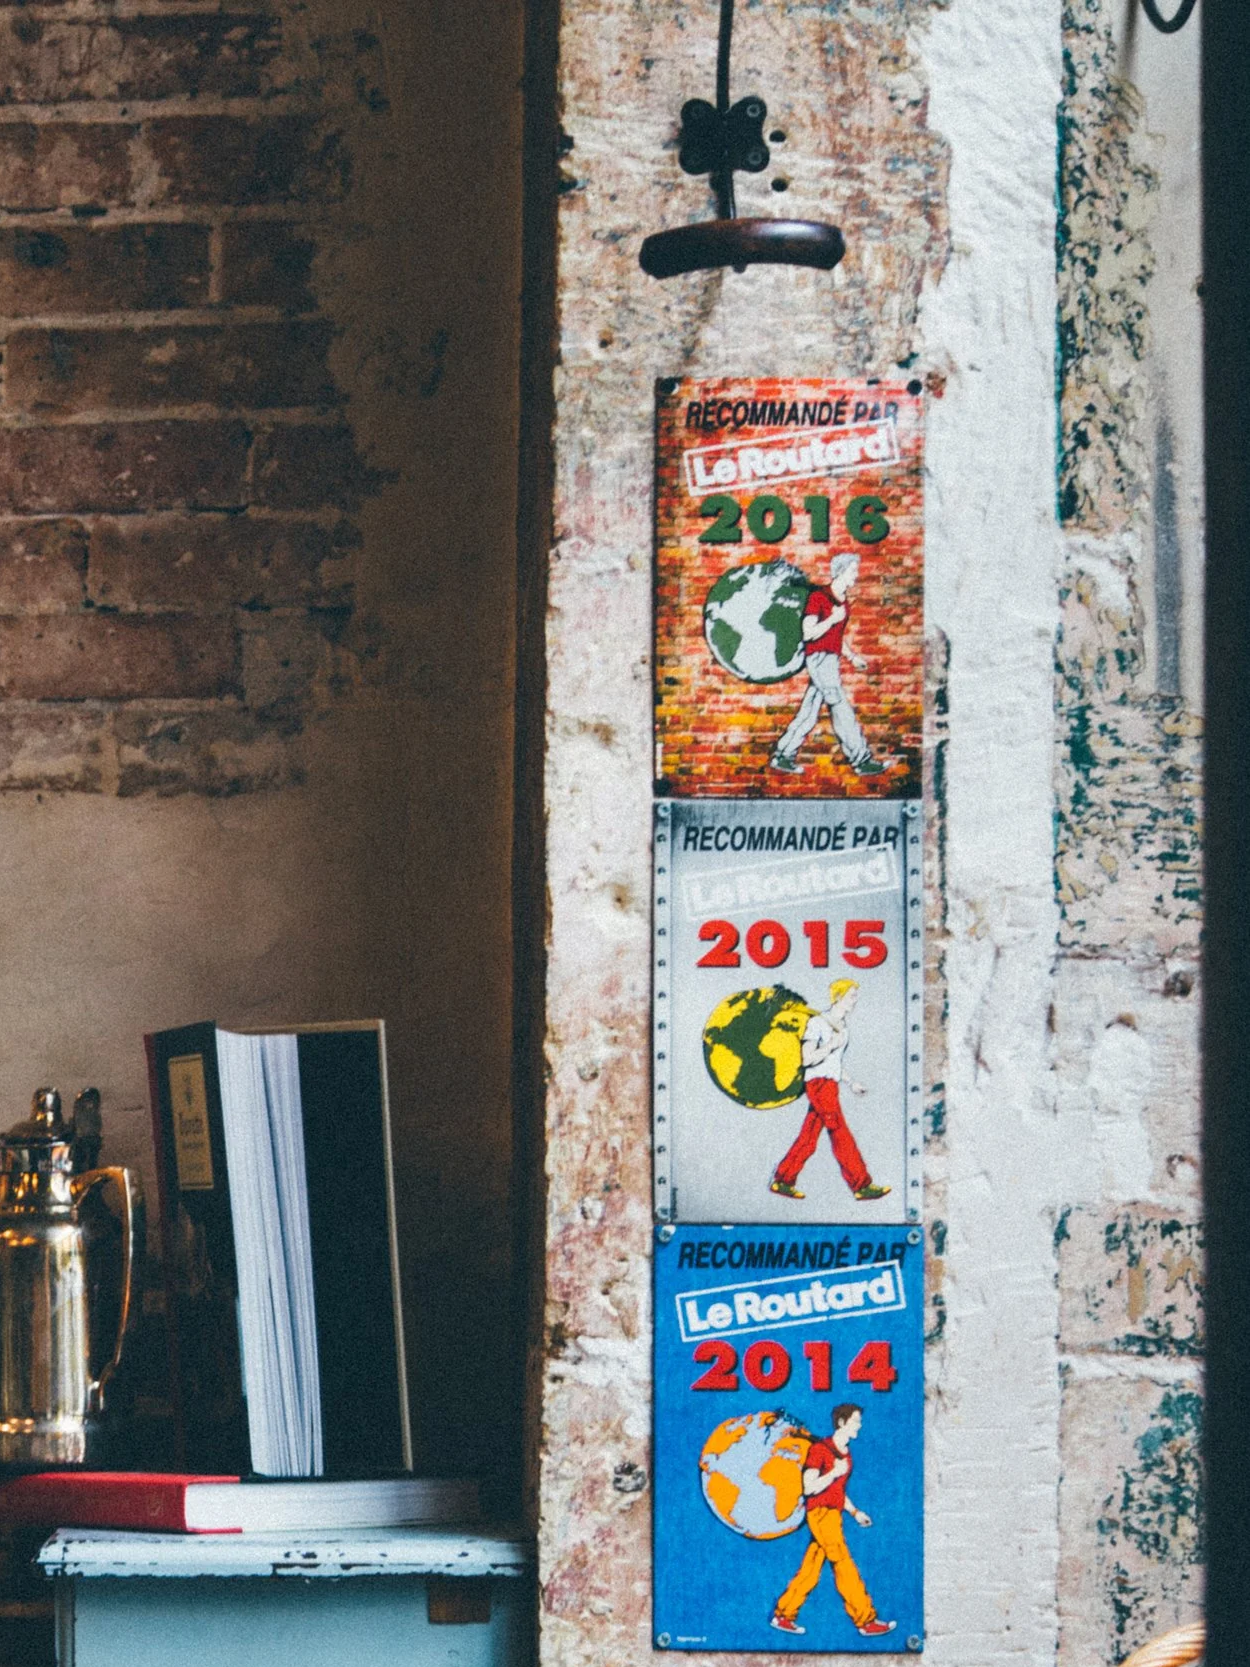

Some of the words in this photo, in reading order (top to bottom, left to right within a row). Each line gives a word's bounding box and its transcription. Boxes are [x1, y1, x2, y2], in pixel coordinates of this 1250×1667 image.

[685, 395, 848, 428] RECOMMANDÉ
[853, 401, 899, 426] PAR
[698, 495, 891, 544] 2016
[683, 822, 847, 851] RECOMMANDÉ
[852, 826, 899, 850] PAR
[695, 919, 888, 969] 2015
[677, 1236, 852, 1270] RECOMMANDÉ
[857, 1241, 908, 1269] PAR
[690, 1340, 898, 1392] 2014
